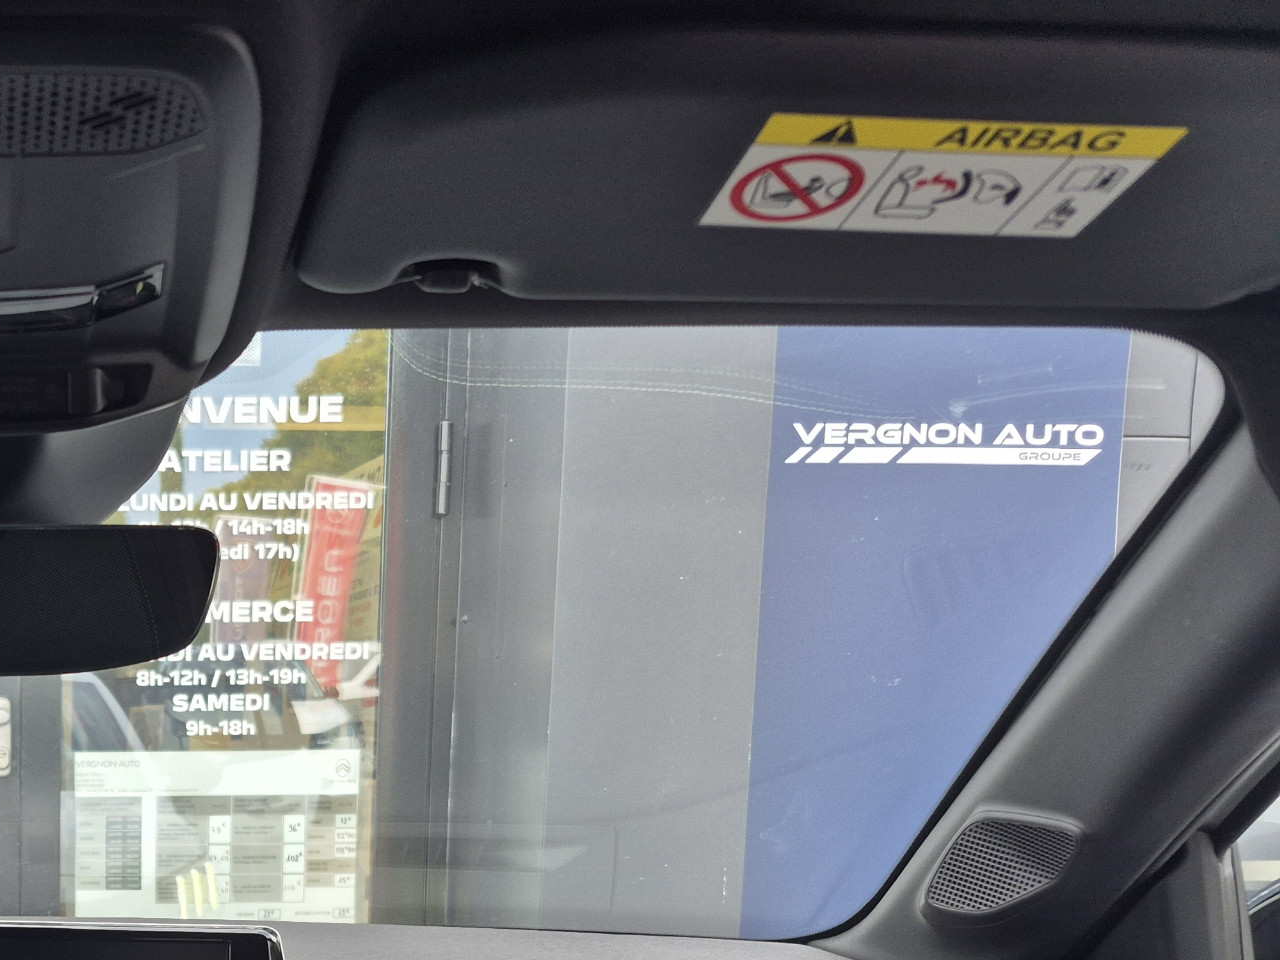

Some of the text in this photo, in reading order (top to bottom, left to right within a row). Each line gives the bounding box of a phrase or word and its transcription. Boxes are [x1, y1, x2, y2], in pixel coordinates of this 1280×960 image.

[935, 125, 1126, 153] AIRBAG
[181, 396, 344, 424] NVENUE
[792, 422, 1105, 446] VERGNON AUTO
[158, 450, 291, 472] ATELIER
[1019, 452, 1082, 461] GROUPE
[200, 493, 237, 511] AU
[243, 492, 373, 511] VENDREDI
[228, 519, 310, 535] 14h-18h
[205, 601, 314, 623] MERCE
[198, 643, 238, 661] AU
[242, 642, 369, 661] VENDREDI
[136, 669, 206, 687] 8h-12h
[225, 669, 306, 686] 13h-19h
[172, 694, 270, 712] SAMEDI
[186, 719, 255, 736] 9h-18h
